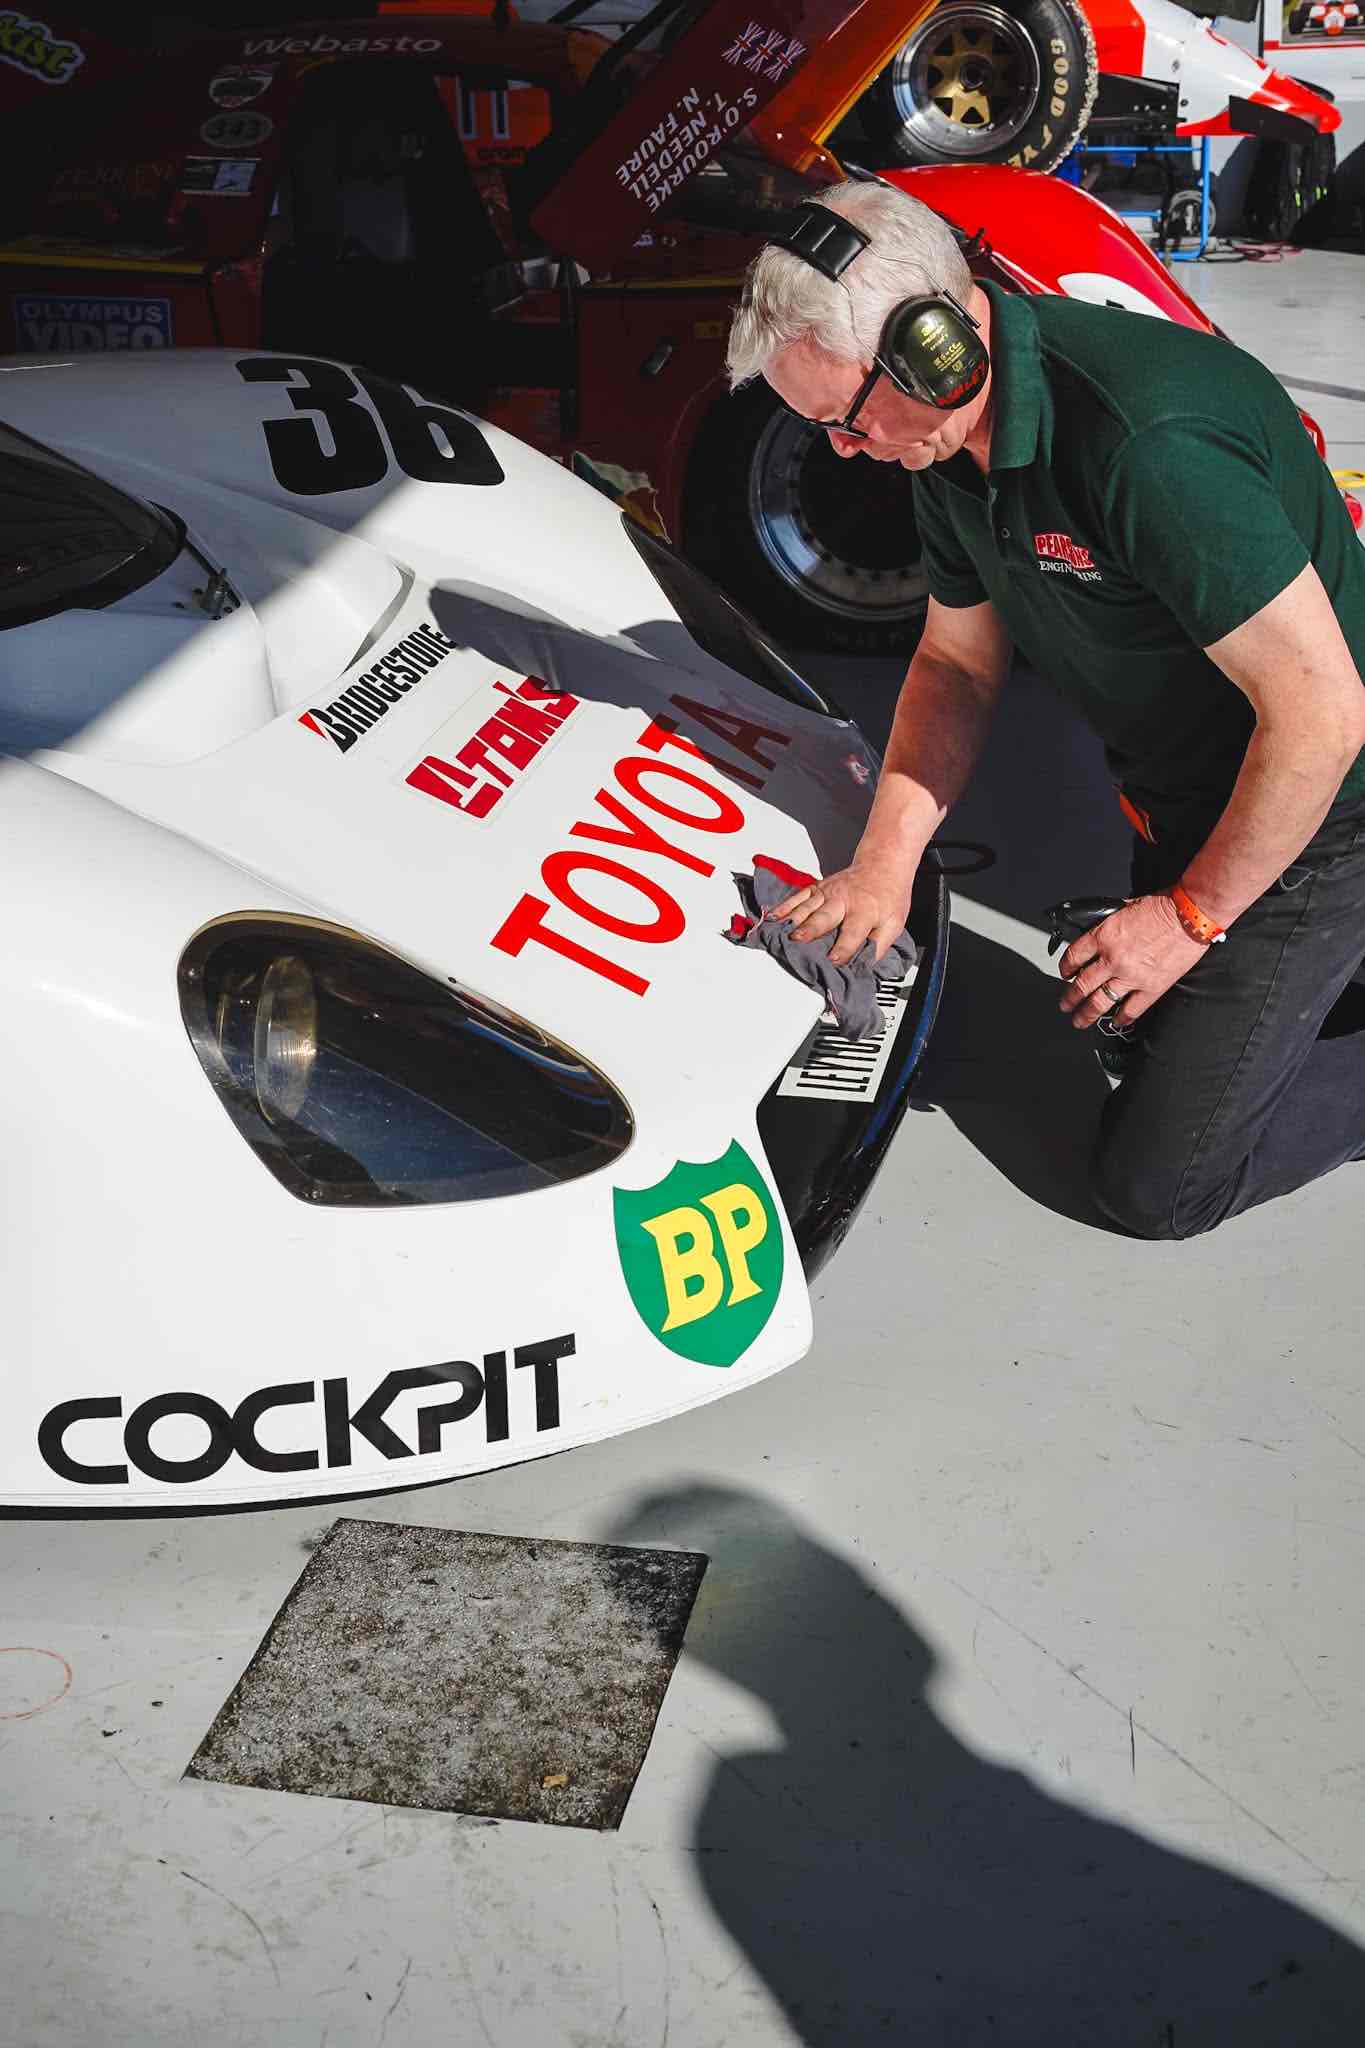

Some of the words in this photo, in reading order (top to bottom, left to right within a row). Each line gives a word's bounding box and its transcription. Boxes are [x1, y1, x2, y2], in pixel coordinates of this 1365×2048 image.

[241, 32, 443, 56] webasto
[616, 112, 680, 185] FAURE
[629, 111, 707, 199] NEEDELL
[22, 302, 162, 323] OLYMPUS
[235, 357, 505, 496] 36
[298, 623, 457, 753] BRIDGESTONE
[490, 693, 792, 997] TOYOTA
[640, 1182, 769, 1333] BP
[37, 1332, 577, 1486] COCKPIT
